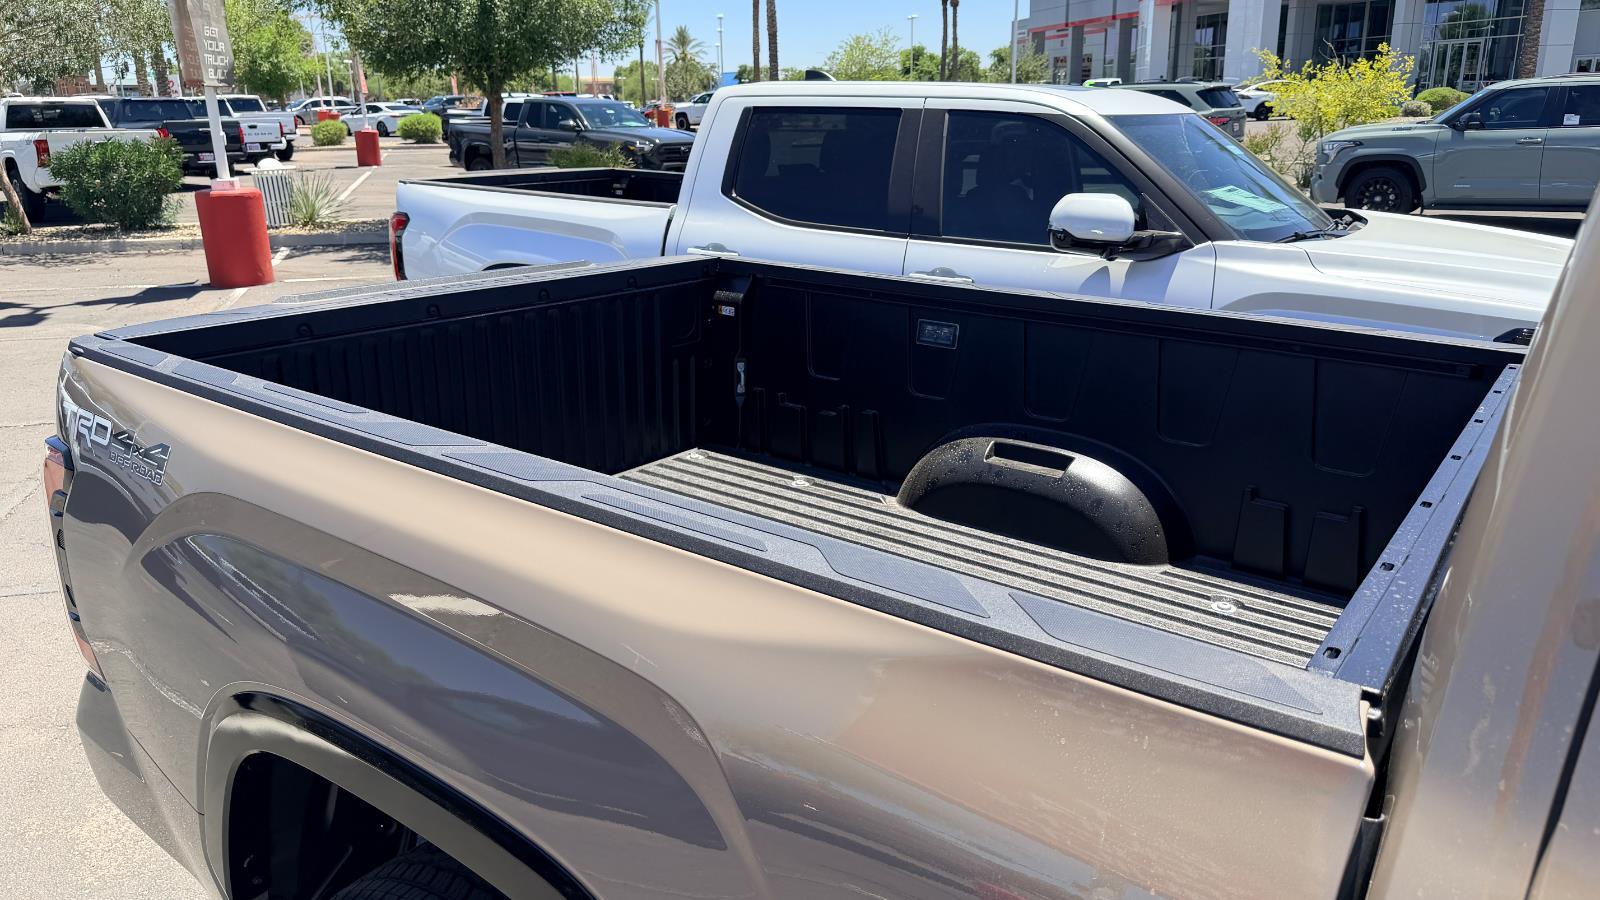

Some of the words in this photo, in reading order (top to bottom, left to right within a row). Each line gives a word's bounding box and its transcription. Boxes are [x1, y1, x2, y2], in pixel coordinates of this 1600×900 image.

[204, 27, 218, 38] GET
[203, 40, 225, 52] YOUR
[204, 54, 228, 66] TRUCK
[209, 68, 228, 79] BUILT
[62, 400, 113, 448] TRD
[110, 451, 131, 468] OFF
[132, 461, 163, 485] ROAD
